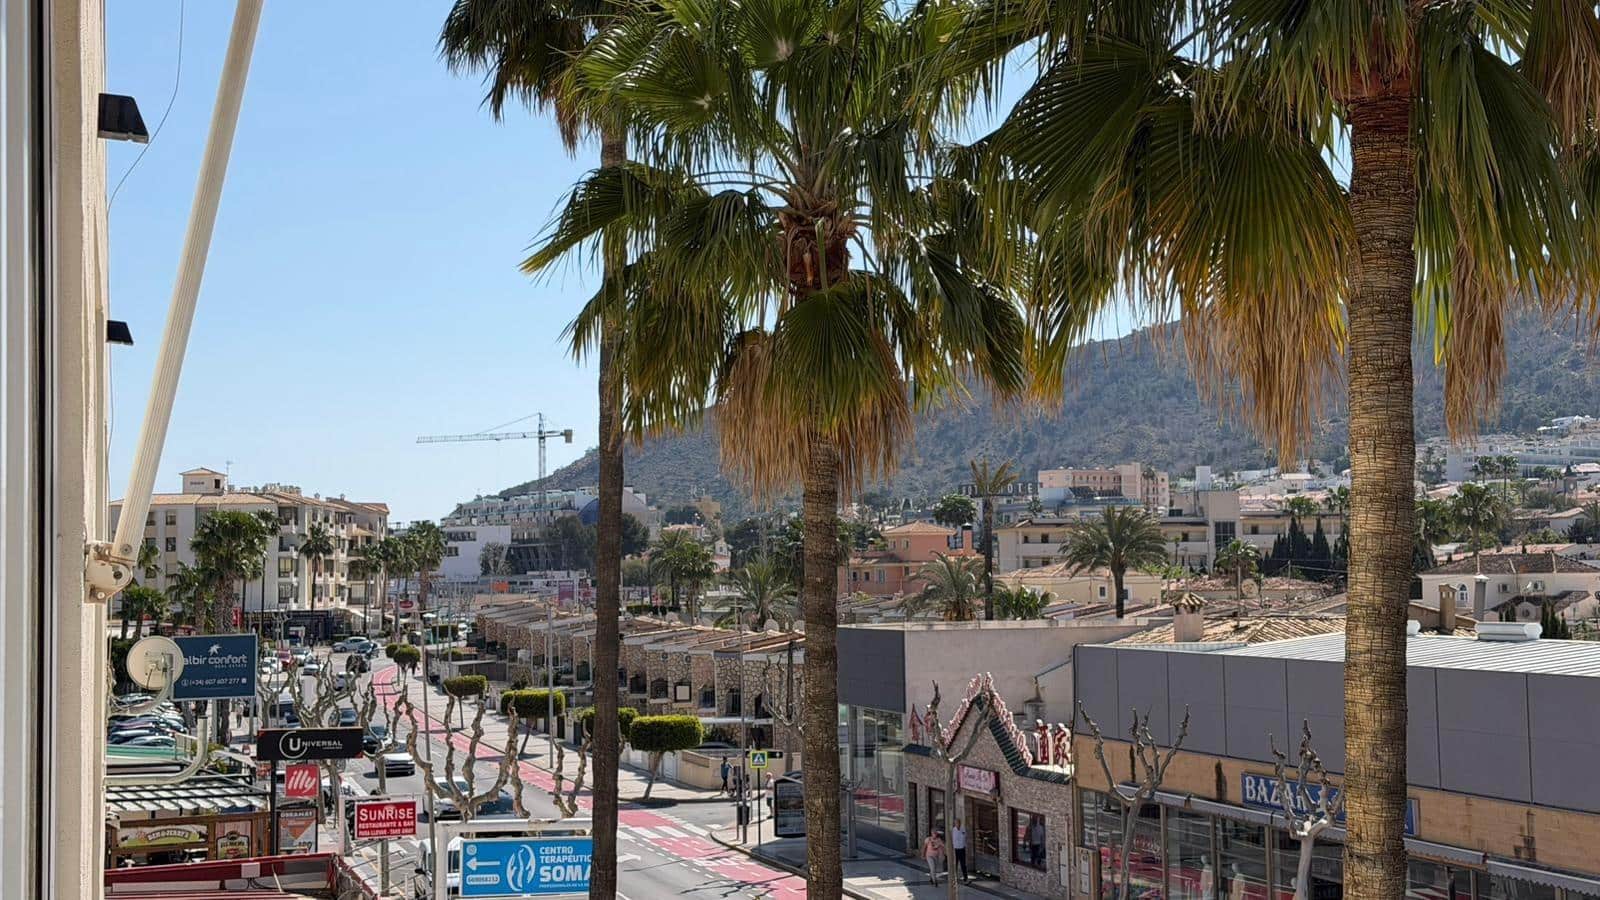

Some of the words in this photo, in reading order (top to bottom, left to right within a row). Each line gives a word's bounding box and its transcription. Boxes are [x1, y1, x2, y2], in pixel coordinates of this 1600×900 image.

[183, 655, 207, 665] albir
[208, 654, 248, 665] confort
[288, 769, 317, 794] illy
[359, 807, 414, 821] SUNRISE
[539, 846, 573, 855] CENTRO
